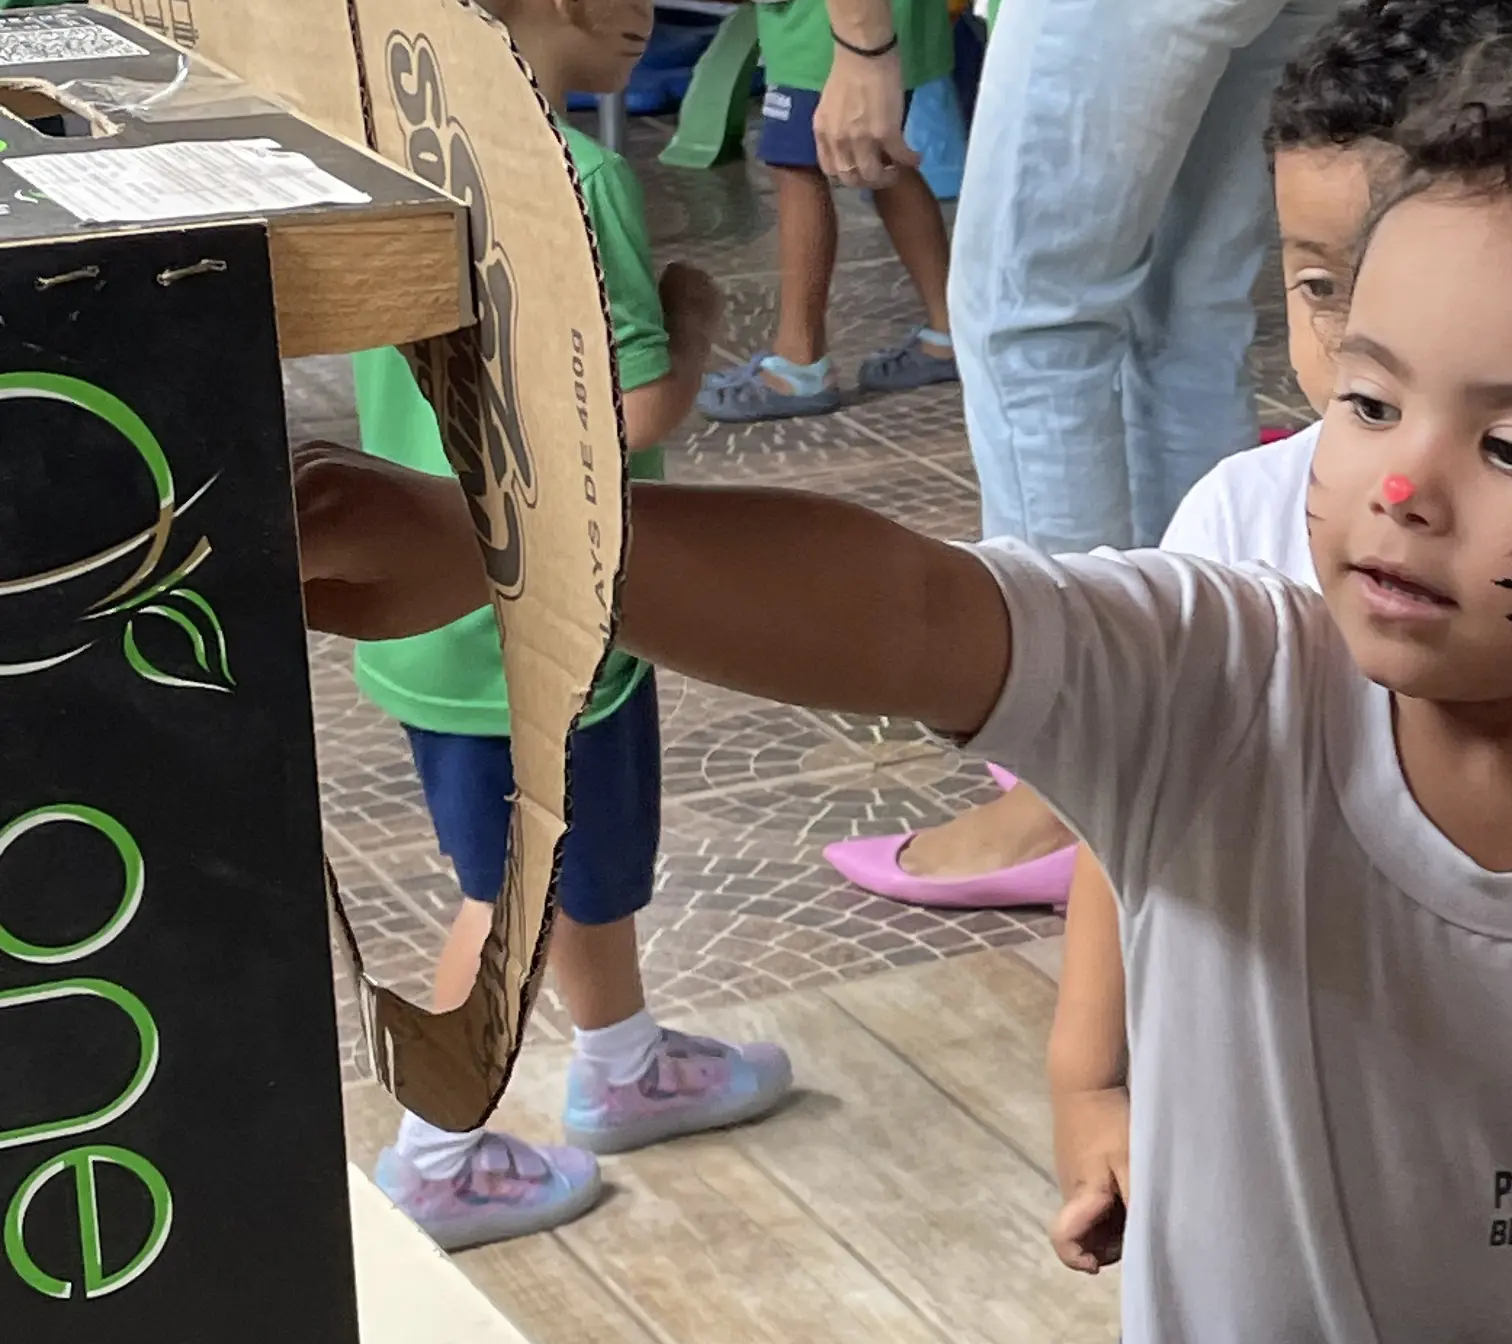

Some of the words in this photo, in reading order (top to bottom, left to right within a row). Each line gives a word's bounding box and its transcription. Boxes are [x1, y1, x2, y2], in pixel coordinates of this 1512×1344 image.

[571, 327, 589, 432] 480g
[580, 440, 597, 506] DE
[587, 519, 612, 642] LAYS
[0, 803, 173, 1299] one
